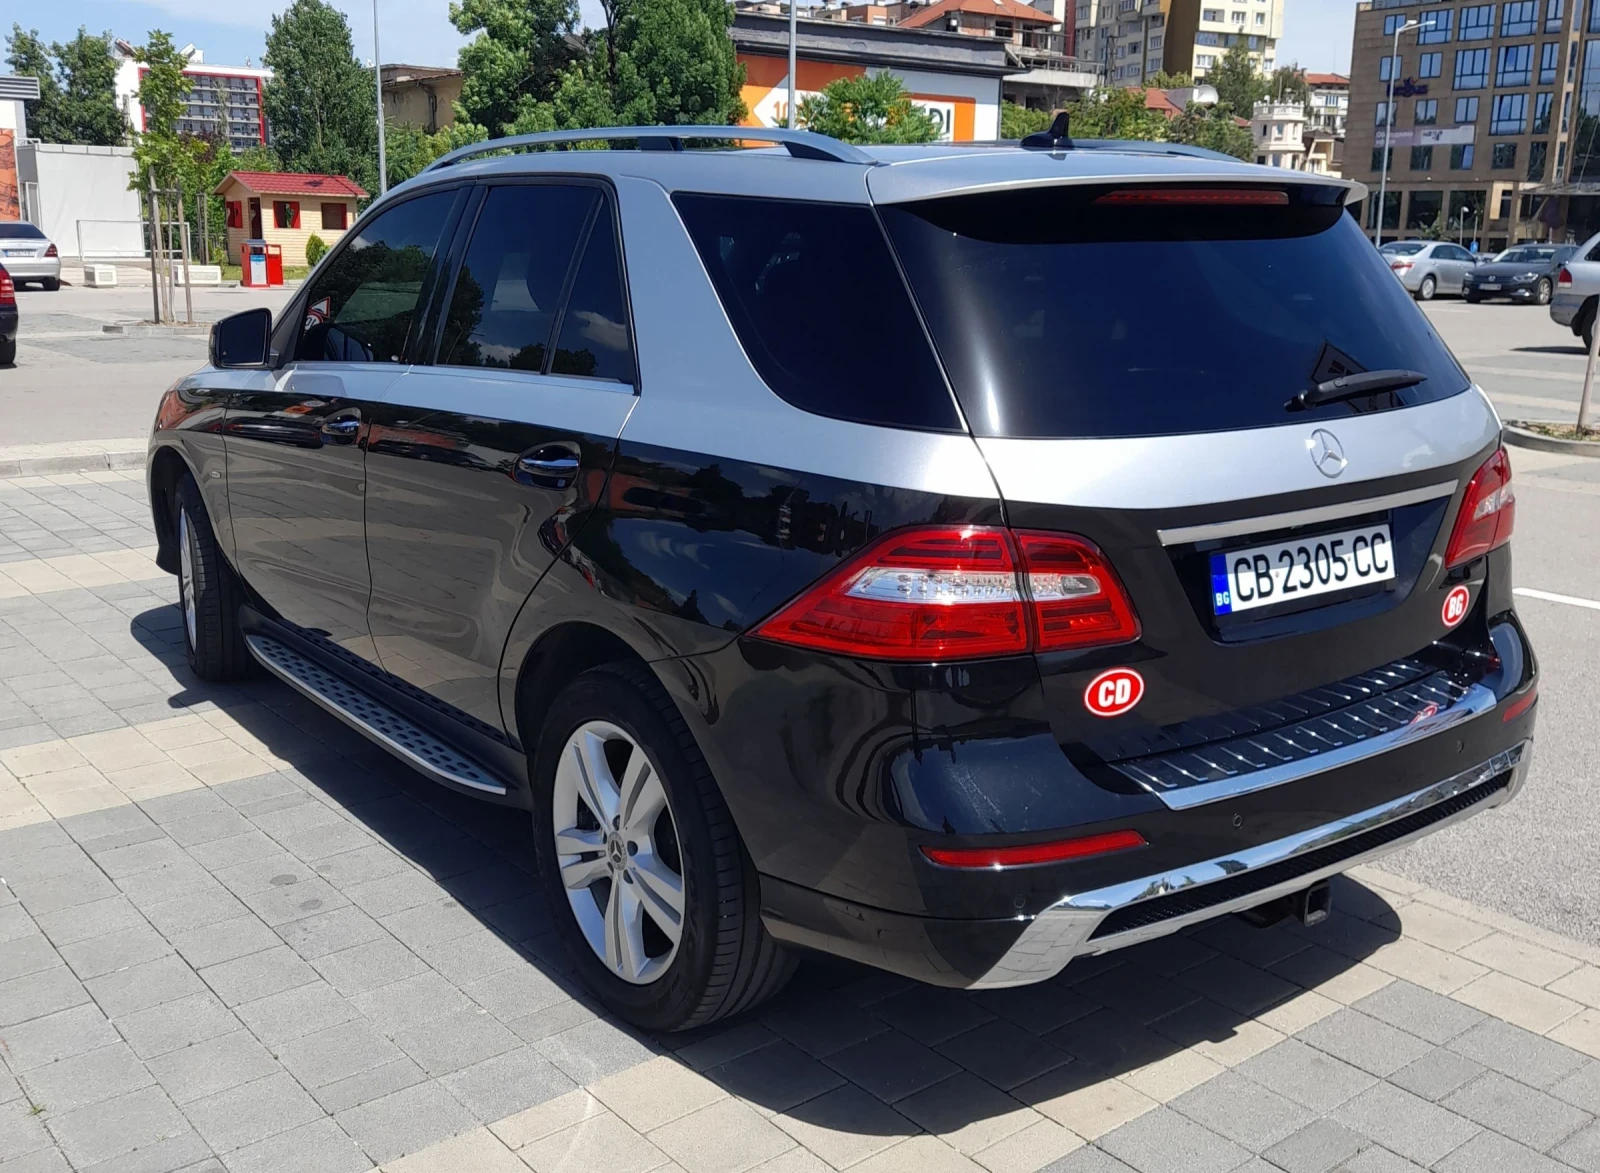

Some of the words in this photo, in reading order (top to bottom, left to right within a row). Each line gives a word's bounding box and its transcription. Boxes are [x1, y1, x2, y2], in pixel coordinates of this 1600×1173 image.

[1233, 554, 1274, 602] CB
[1278, 539, 1348, 593] 2305
[1352, 532, 1388, 577] CC
[1215, 592, 1230, 606] BG
[1447, 593, 1464, 620] BG
[1098, 678, 1131, 708] CD
